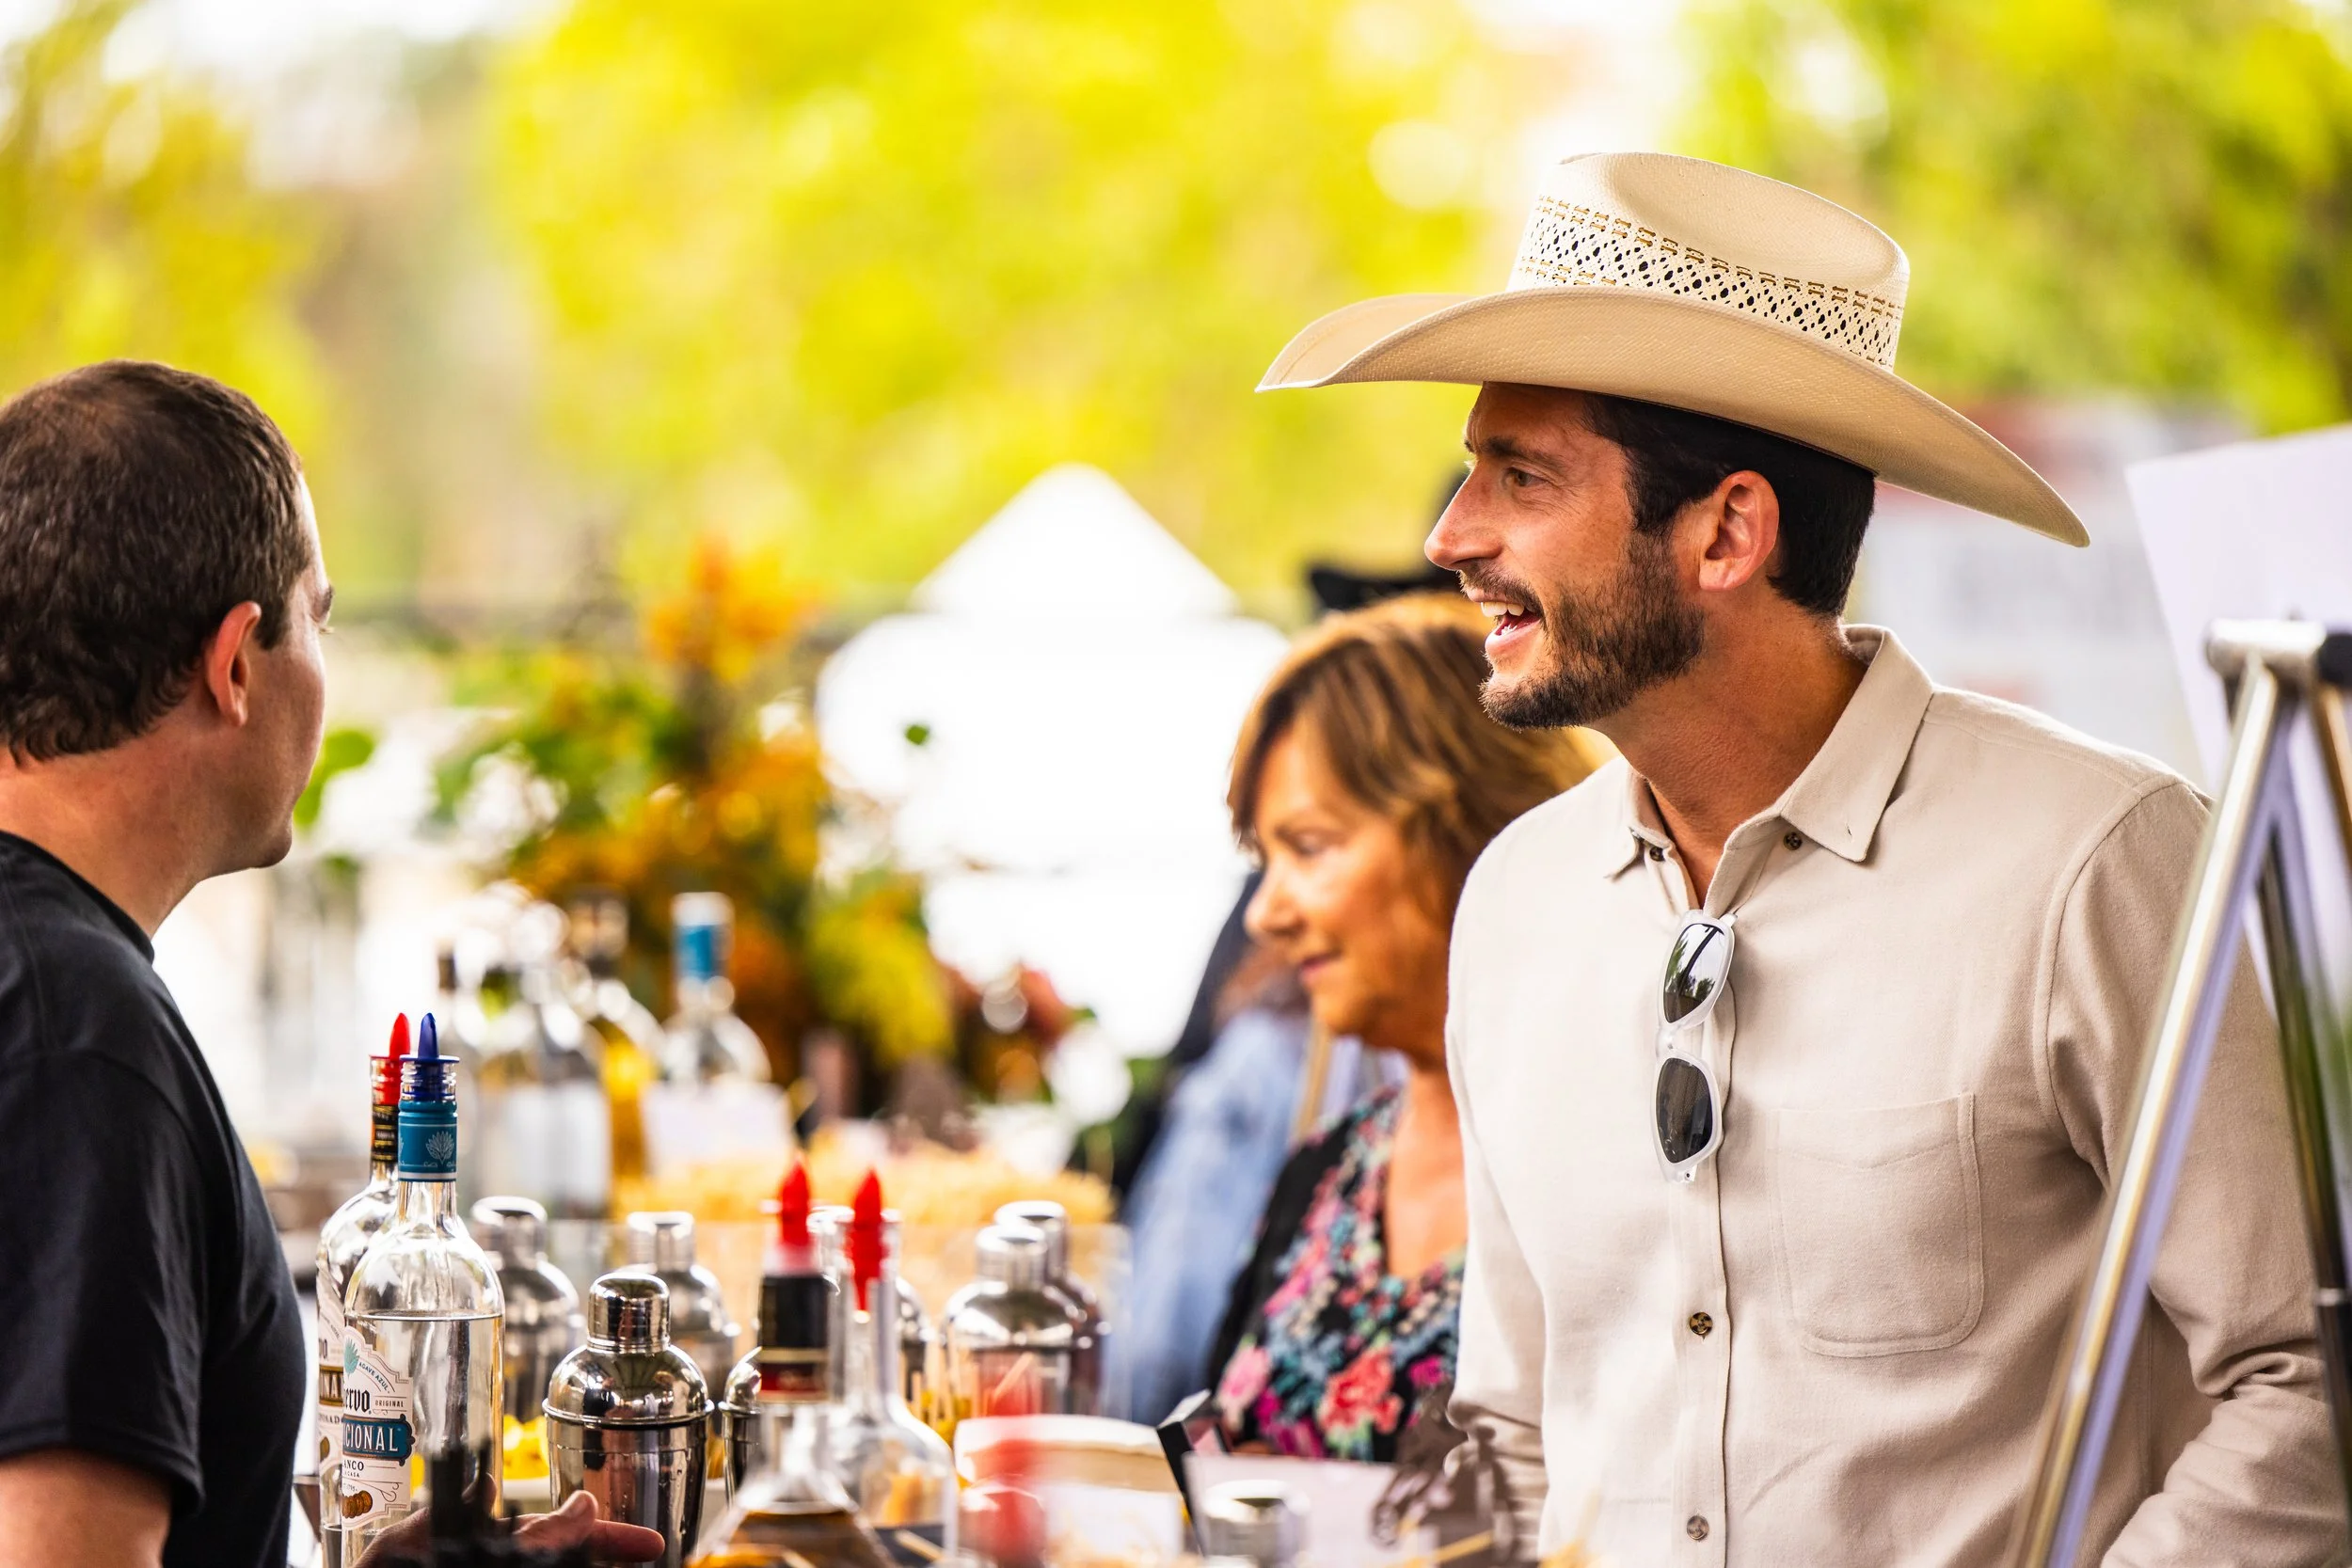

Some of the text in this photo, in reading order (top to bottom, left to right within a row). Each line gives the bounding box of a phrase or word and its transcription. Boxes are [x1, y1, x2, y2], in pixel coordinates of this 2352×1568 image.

[358, 1361, 389, 1391] AGAVE AZUL
[374, 1400, 404, 1408] ORIGINAL
[343, 1459, 365, 1472] ANCO
